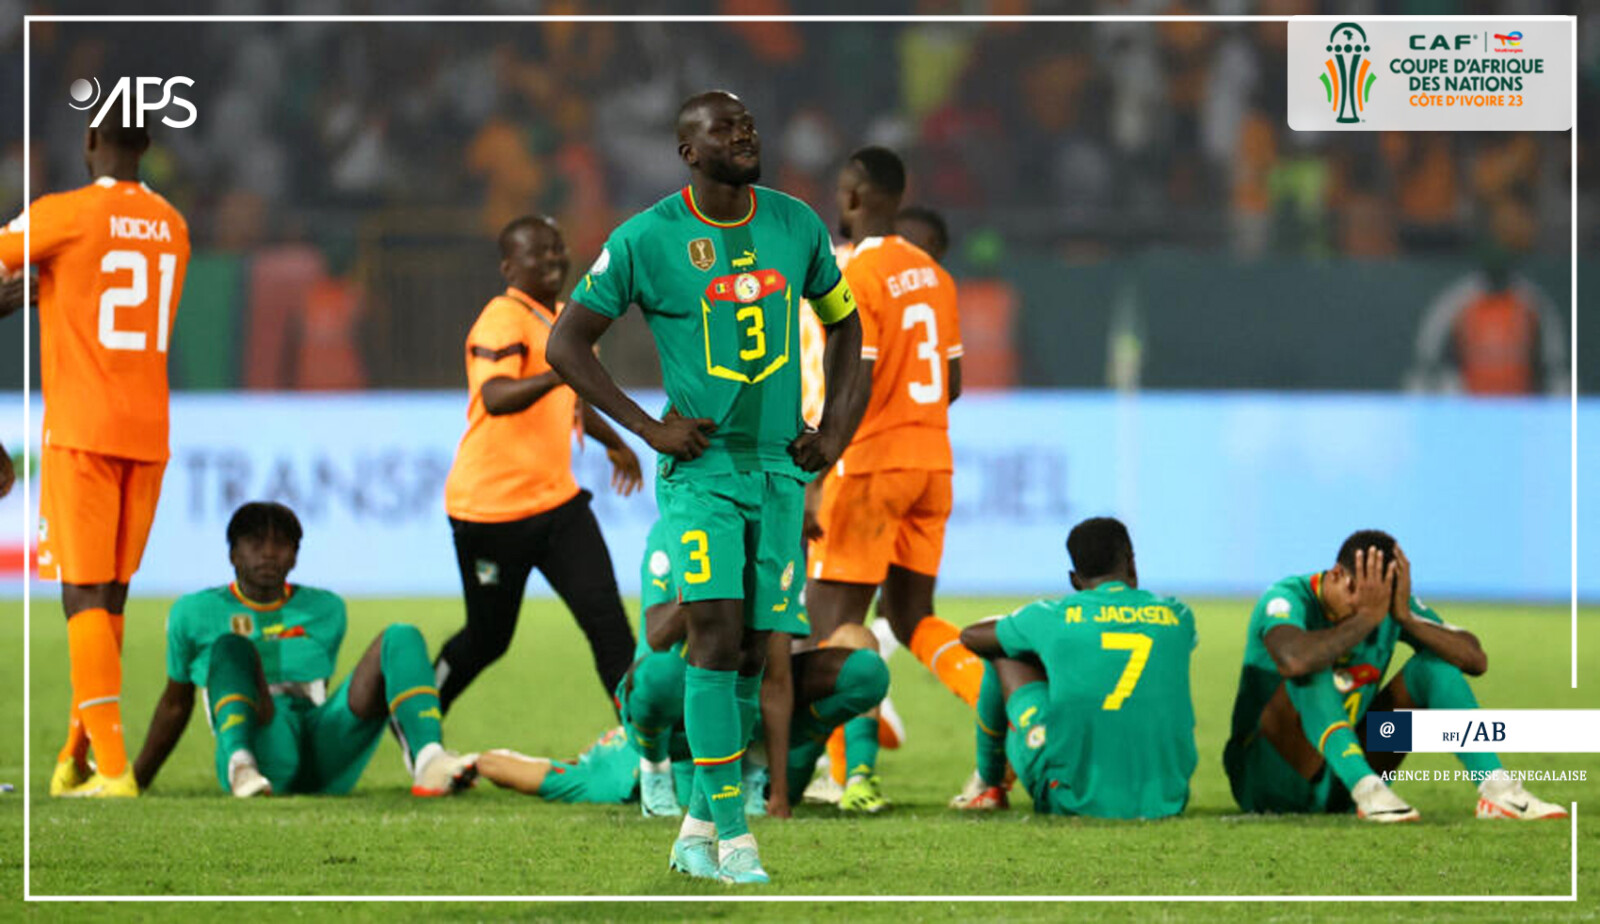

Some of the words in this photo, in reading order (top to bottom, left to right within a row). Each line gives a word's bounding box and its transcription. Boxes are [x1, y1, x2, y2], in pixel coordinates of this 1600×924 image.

[98, 250, 177, 352] 21
[736, 305, 766, 361] 3
[902, 303, 943, 404] 3
[681, 530, 711, 584] 3
[1093, 605, 1180, 626] JACKSON
[1101, 632, 1154, 710] 7
